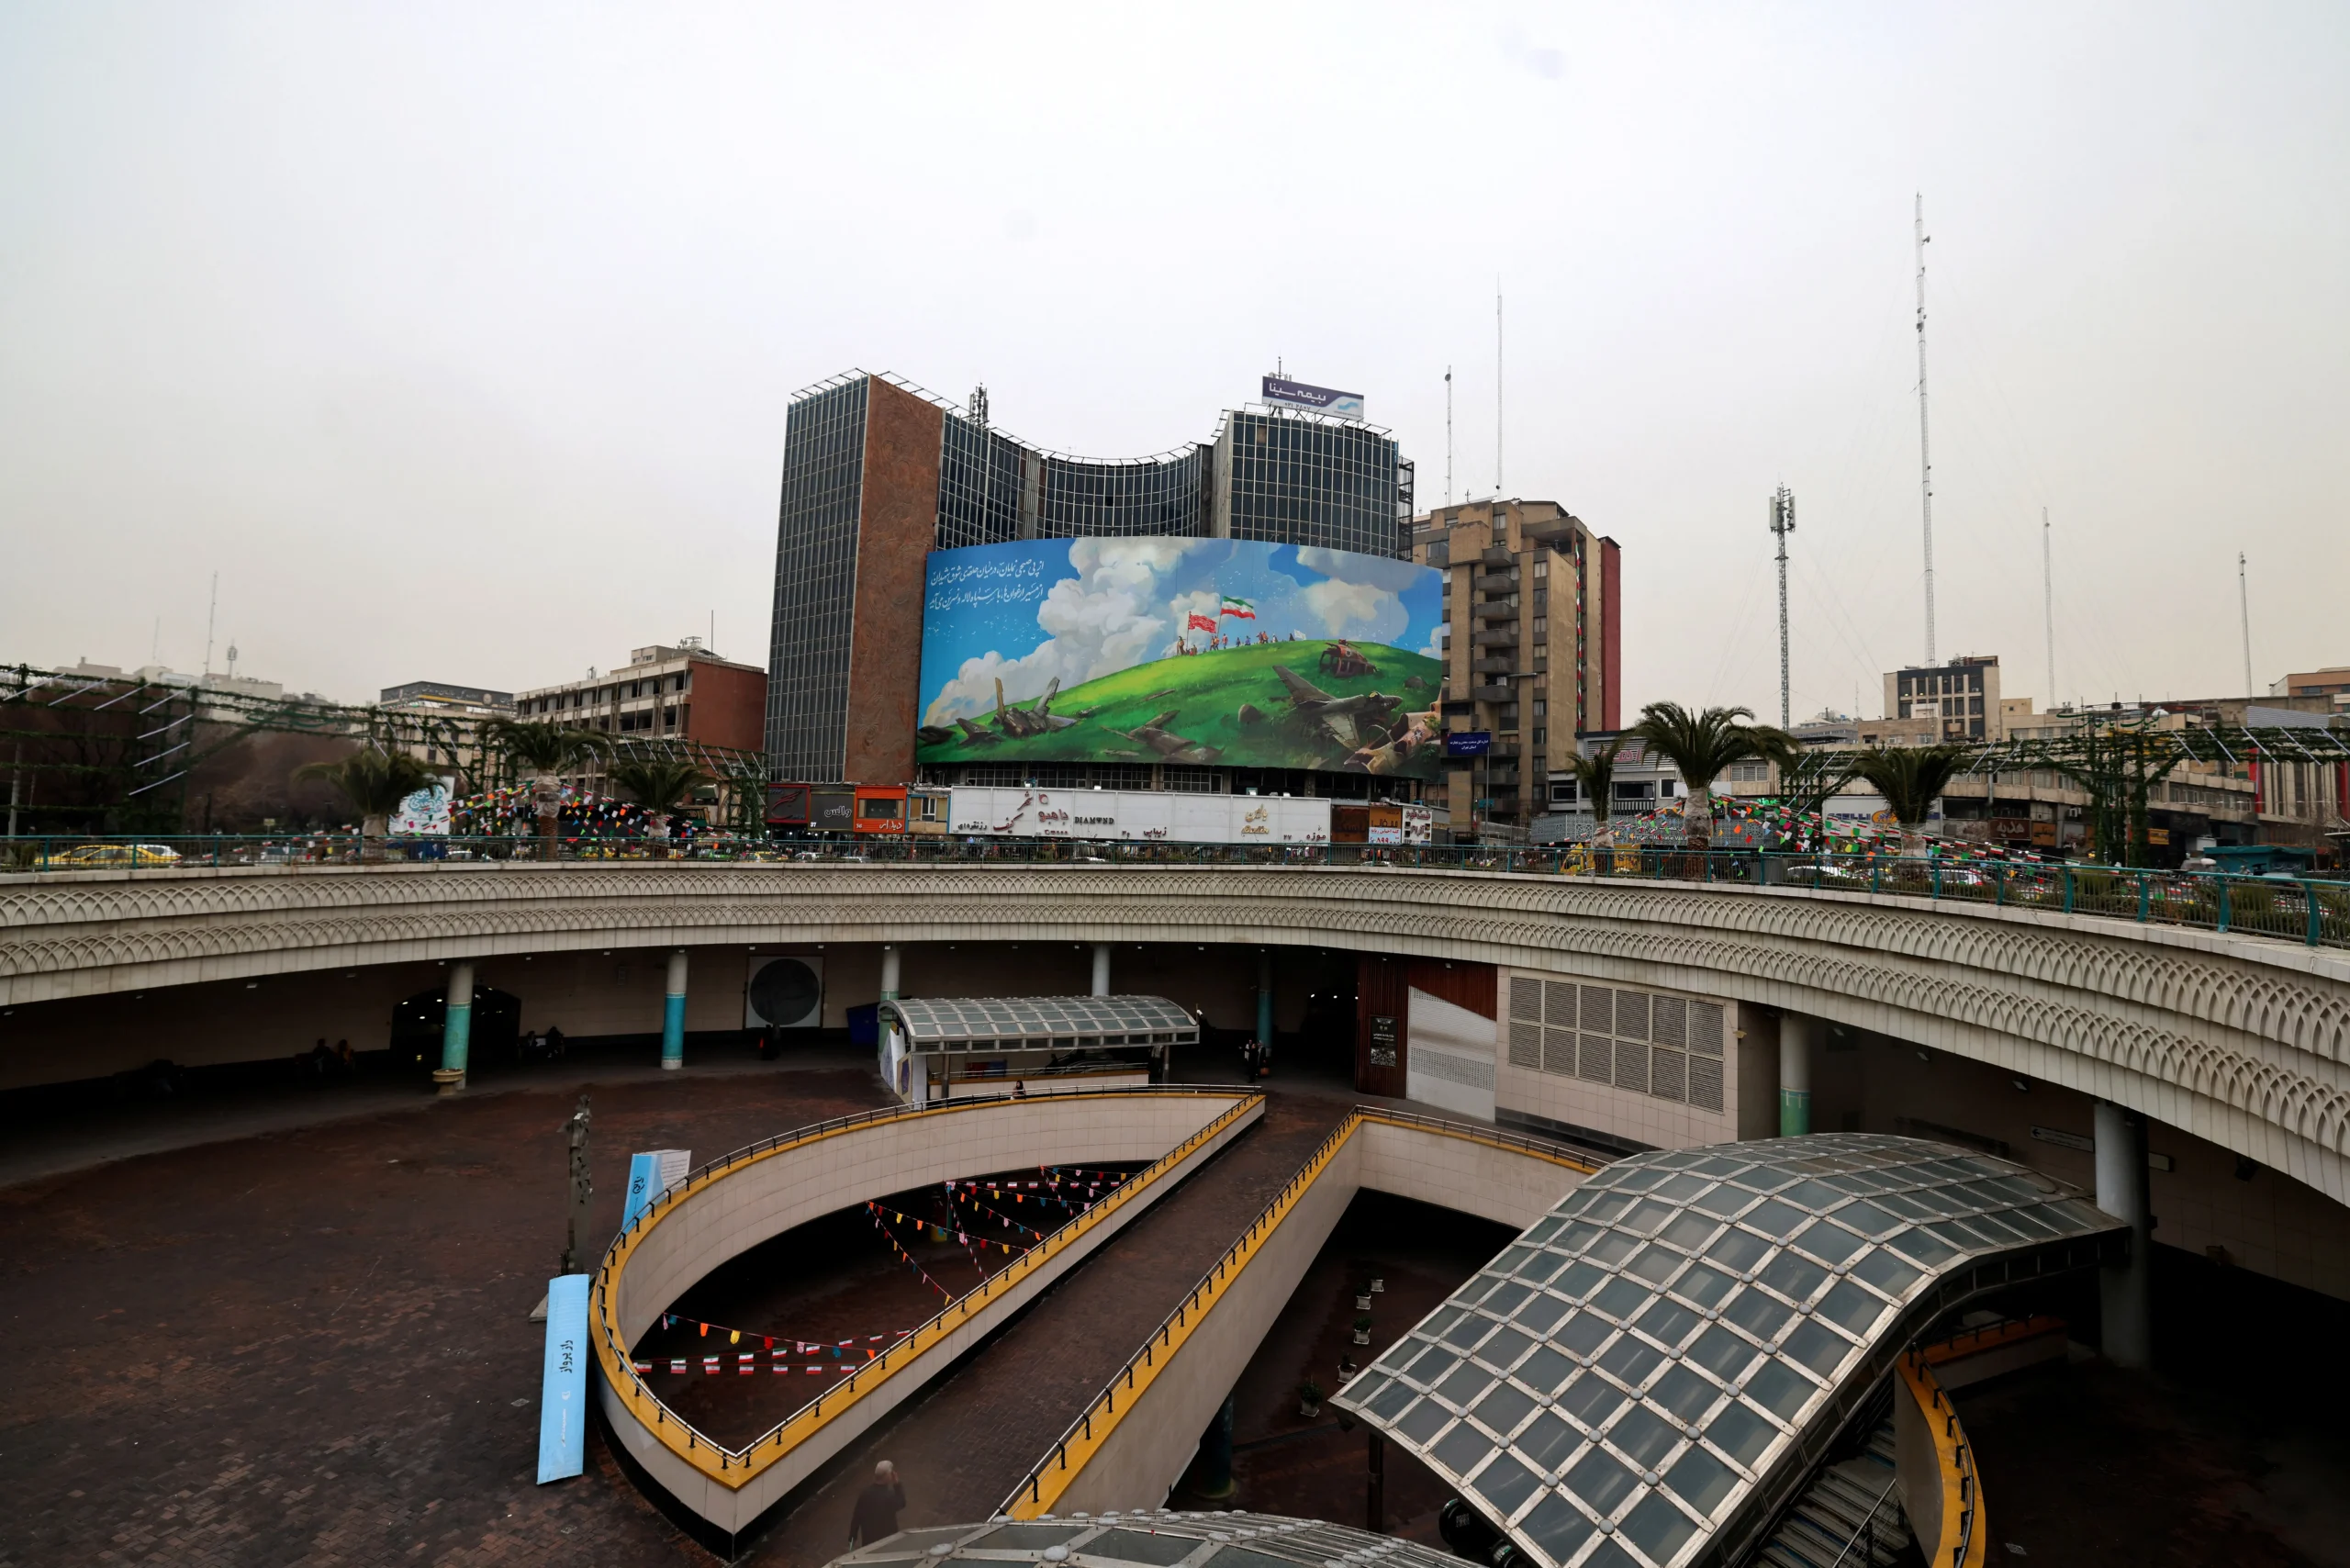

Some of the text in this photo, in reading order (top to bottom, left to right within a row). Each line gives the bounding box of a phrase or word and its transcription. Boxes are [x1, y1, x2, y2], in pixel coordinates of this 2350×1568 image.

[1269, 382, 1326, 404] بیمه سینا
[879, 819, 902, 830] دیدار
[1997, 821, 2024, 837] هدیه
[1143, 827, 1166, 839] زیبایی
[1306, 832, 1326, 842] موزه
